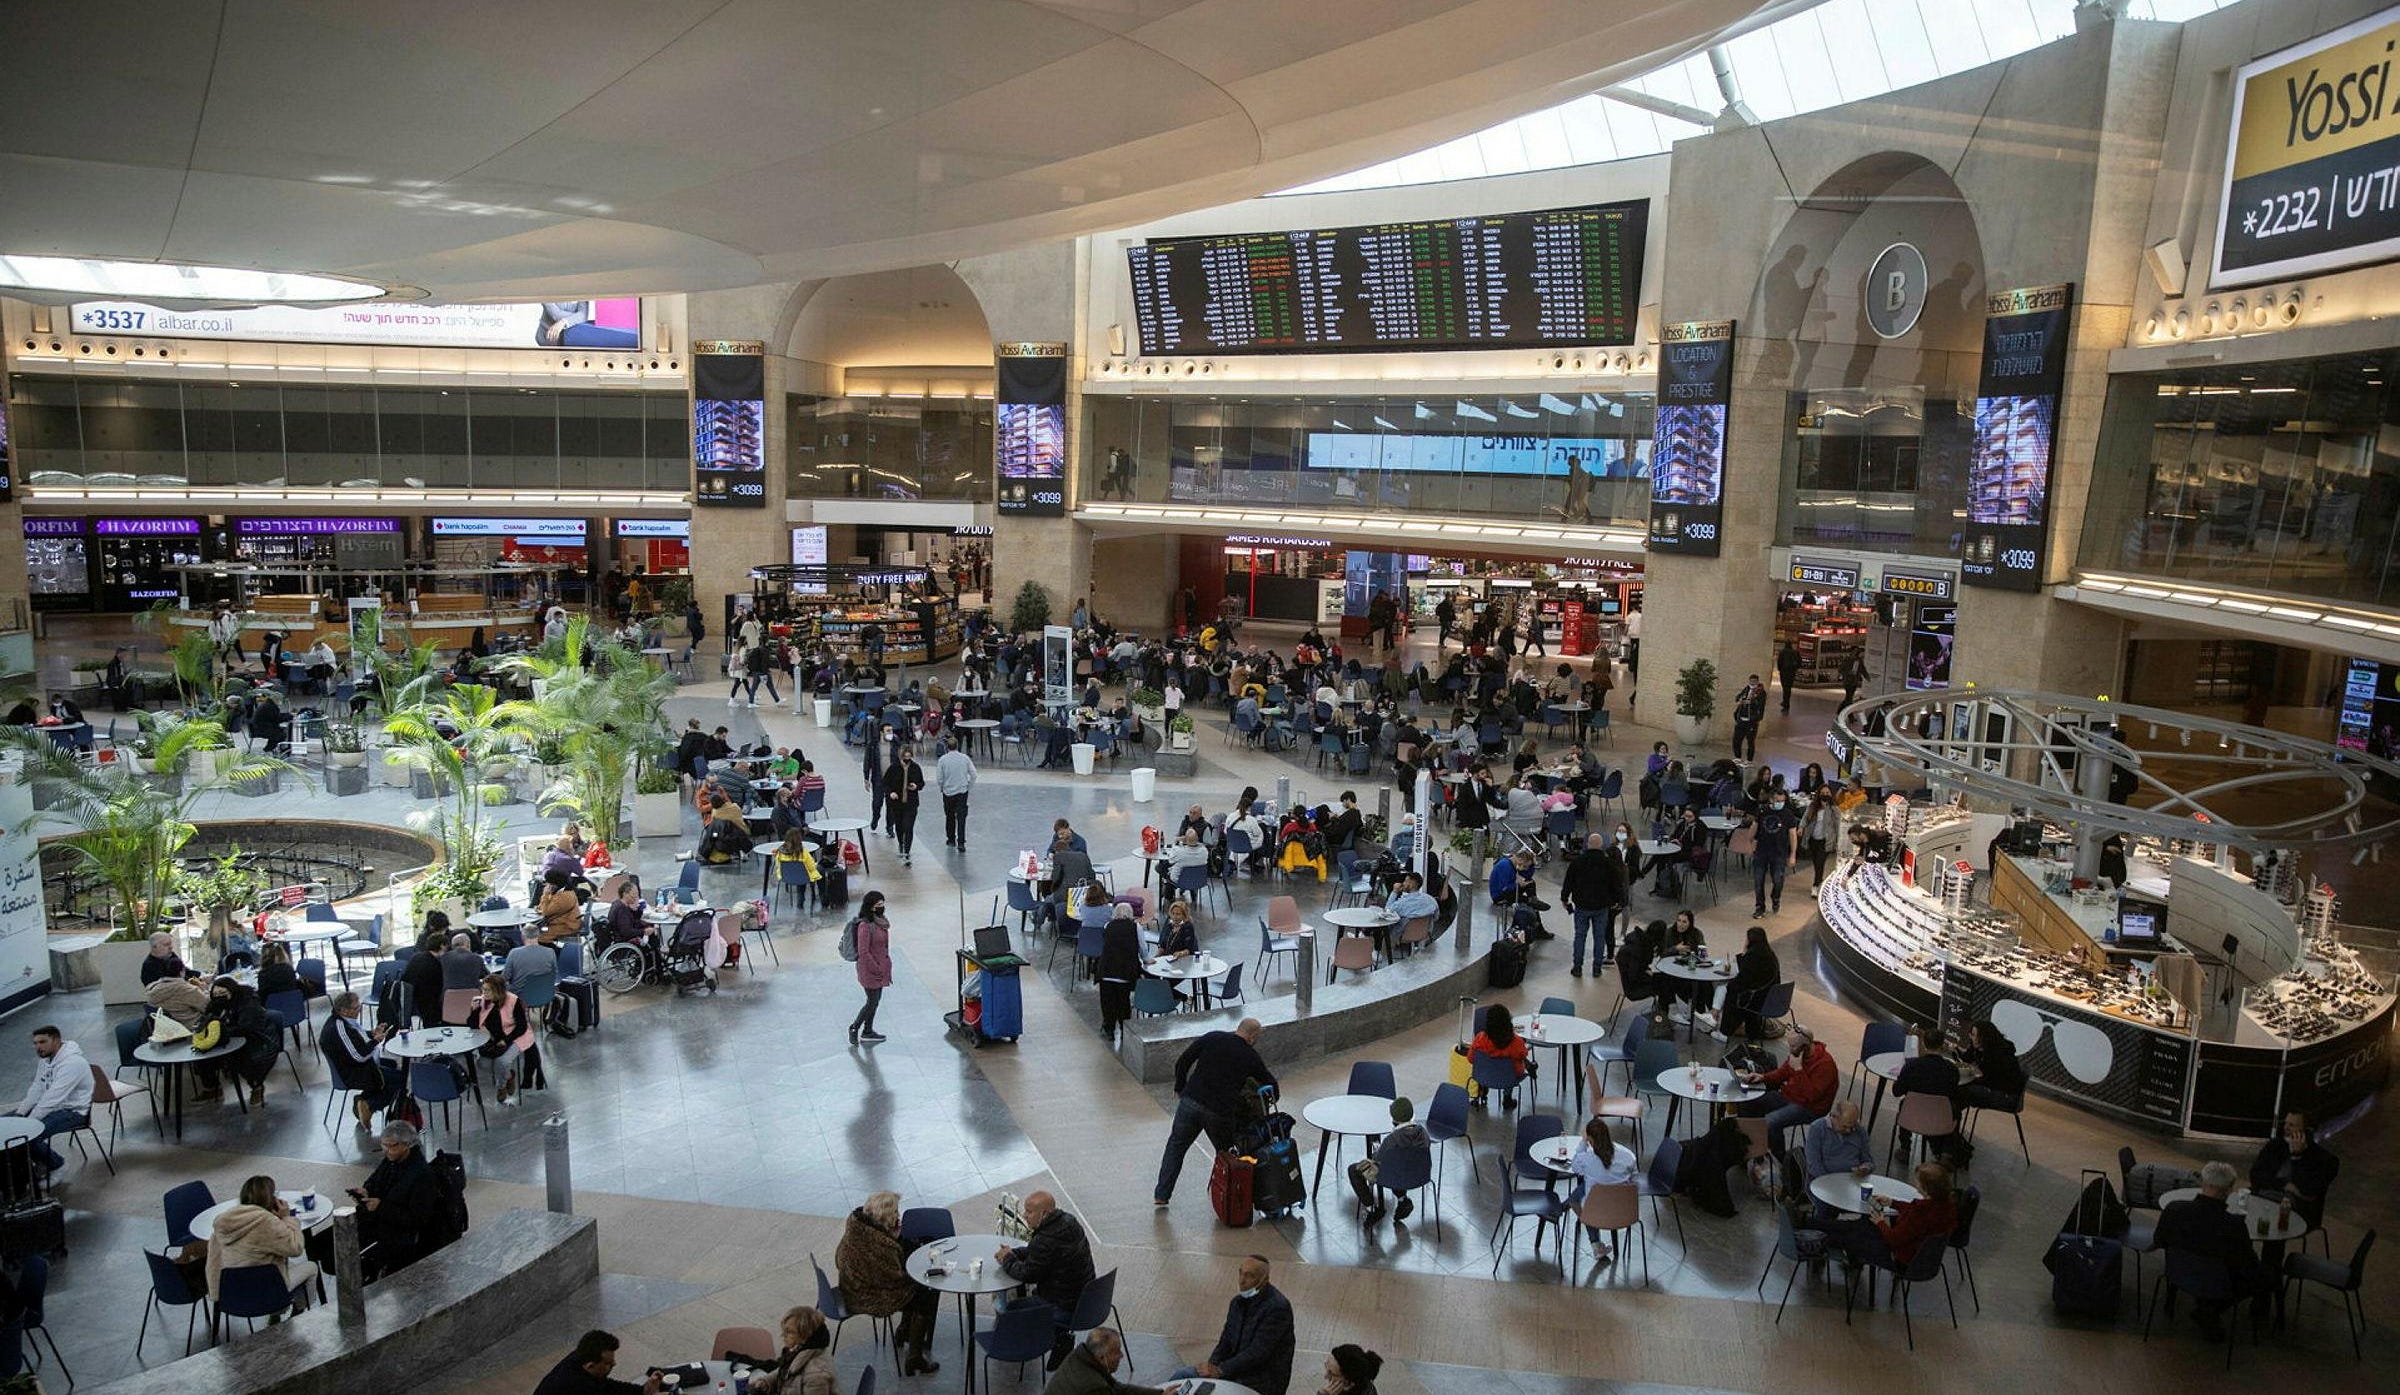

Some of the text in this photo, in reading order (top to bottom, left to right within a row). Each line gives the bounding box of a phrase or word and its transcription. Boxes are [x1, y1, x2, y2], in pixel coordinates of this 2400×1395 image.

[2286, 40, 2395, 148] Yossi
[1886, 270, 1906, 312] B
[158, 314, 233, 333] albar.co.il
[344, 311, 372, 324] שעה!
[375, 312, 393, 326] תוך
[395, 314, 420, 325] חדש
[422, 315, 441, 326] רכב
[1671, 346, 1717, 363] LOCATION
[1668, 383, 1715, 398] PRESTIGE
[1553, 446, 1600, 463] תודה
[24, 521, 78, 533] ORFIM
[107, 521, 191, 533] HAZORFIM
[241, 520, 394, 532] הצורפים HAZORFIM
[857, 574, 881, 585] DUTY
[883, 573, 904, 584] FREE
[130, 590, 178, 598] HAZORFIM
[1937, 583, 1946, 595] B
